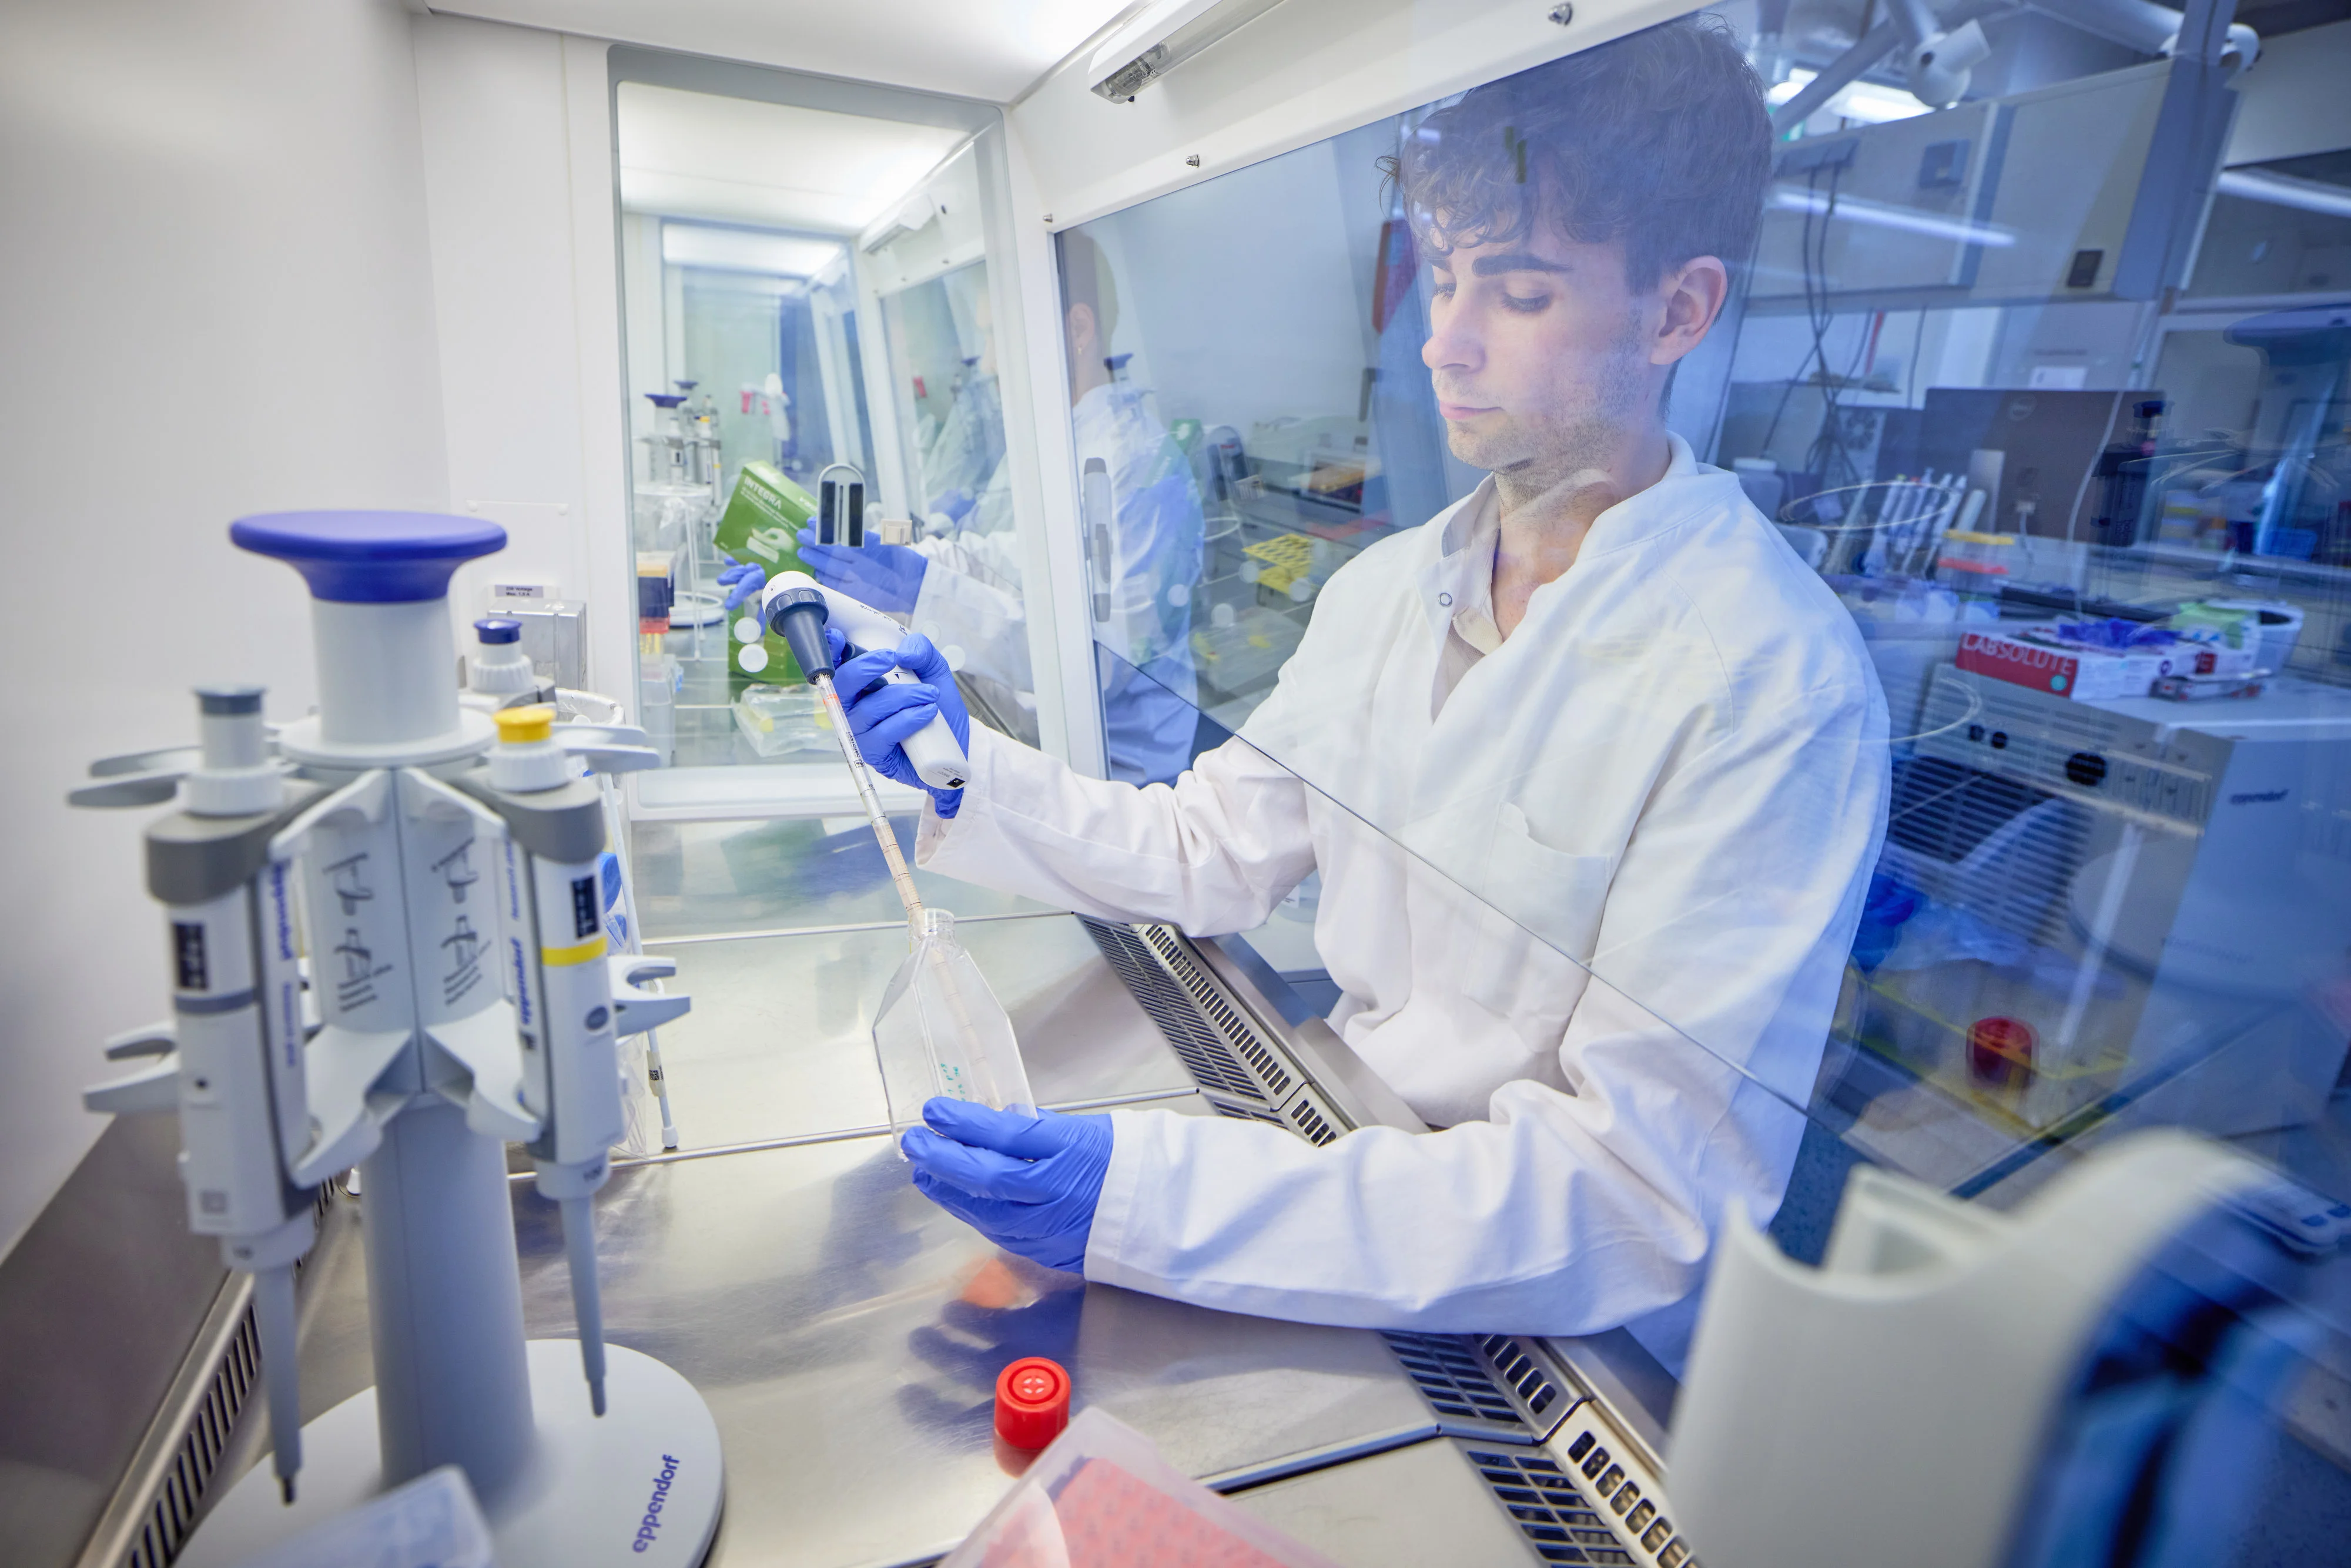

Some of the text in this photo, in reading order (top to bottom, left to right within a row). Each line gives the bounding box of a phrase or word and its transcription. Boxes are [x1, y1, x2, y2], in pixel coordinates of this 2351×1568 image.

[744, 475, 782, 510] INTEGRA
[1961, 633, 2074, 675] LABSOLUTE
[632, 1454, 680, 1553] eppendorf
